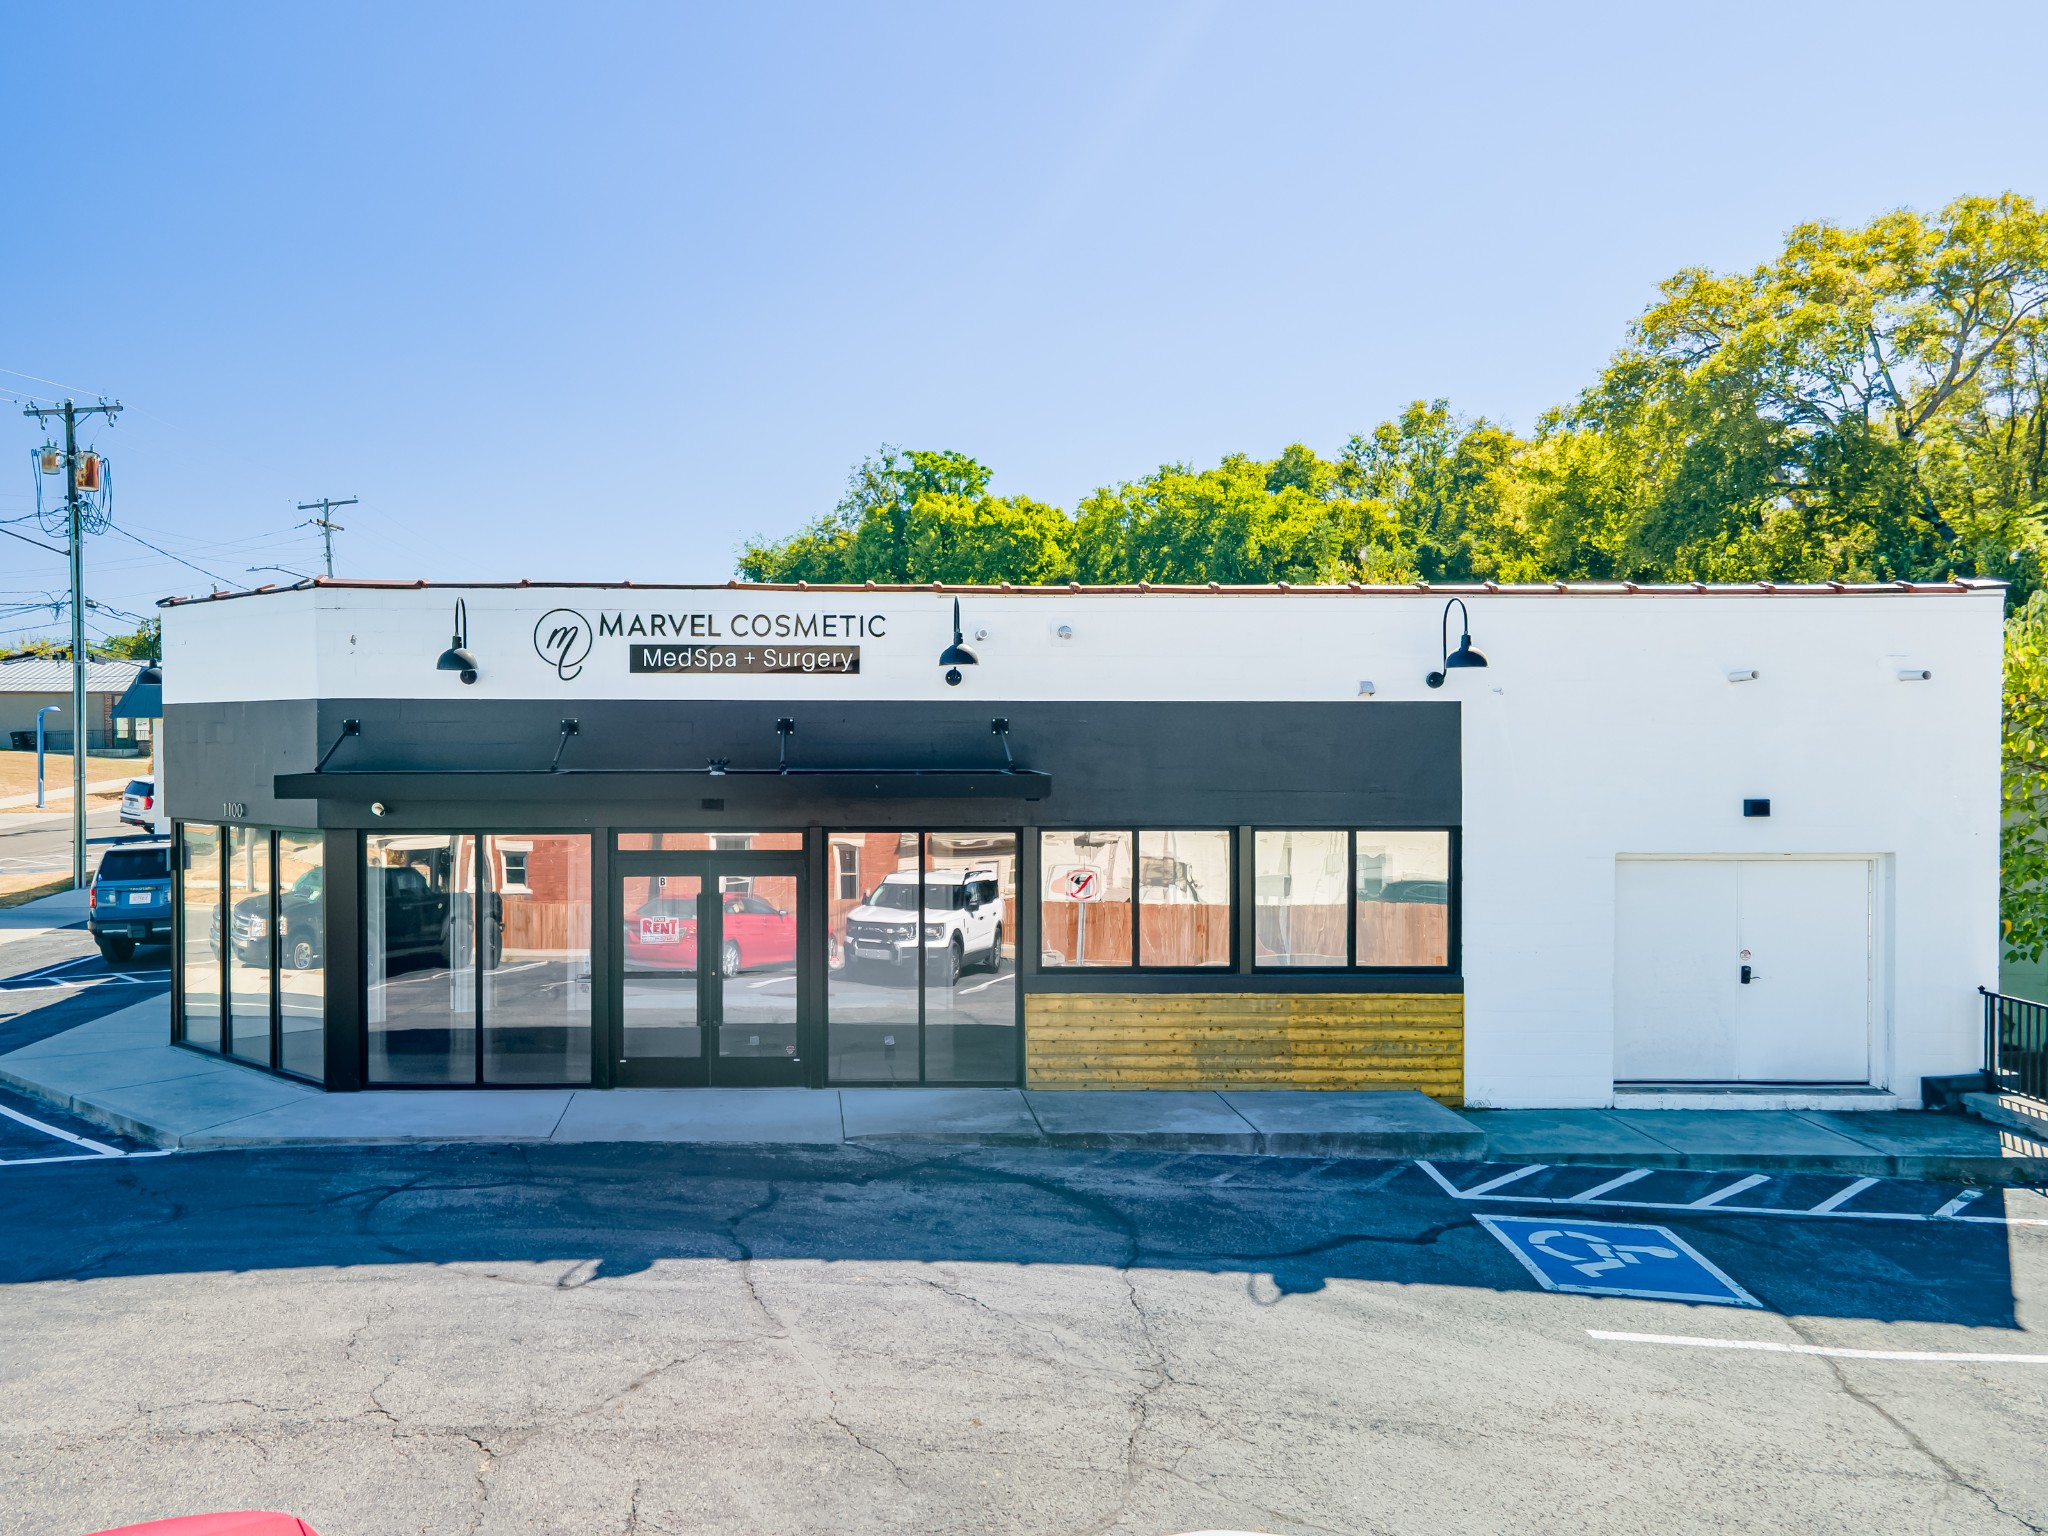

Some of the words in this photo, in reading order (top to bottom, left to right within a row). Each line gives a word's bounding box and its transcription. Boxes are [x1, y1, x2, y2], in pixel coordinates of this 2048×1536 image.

[599, 612, 721, 637] MARVEL
[731, 612, 887, 638] COSMETIC
[643, 648, 737, 671] MedSpa
[744, 651, 756, 665] +
[763, 648, 854, 672] Surgery
[223, 802, 243, 818] 1100
[642, 919, 677, 935] RENT
